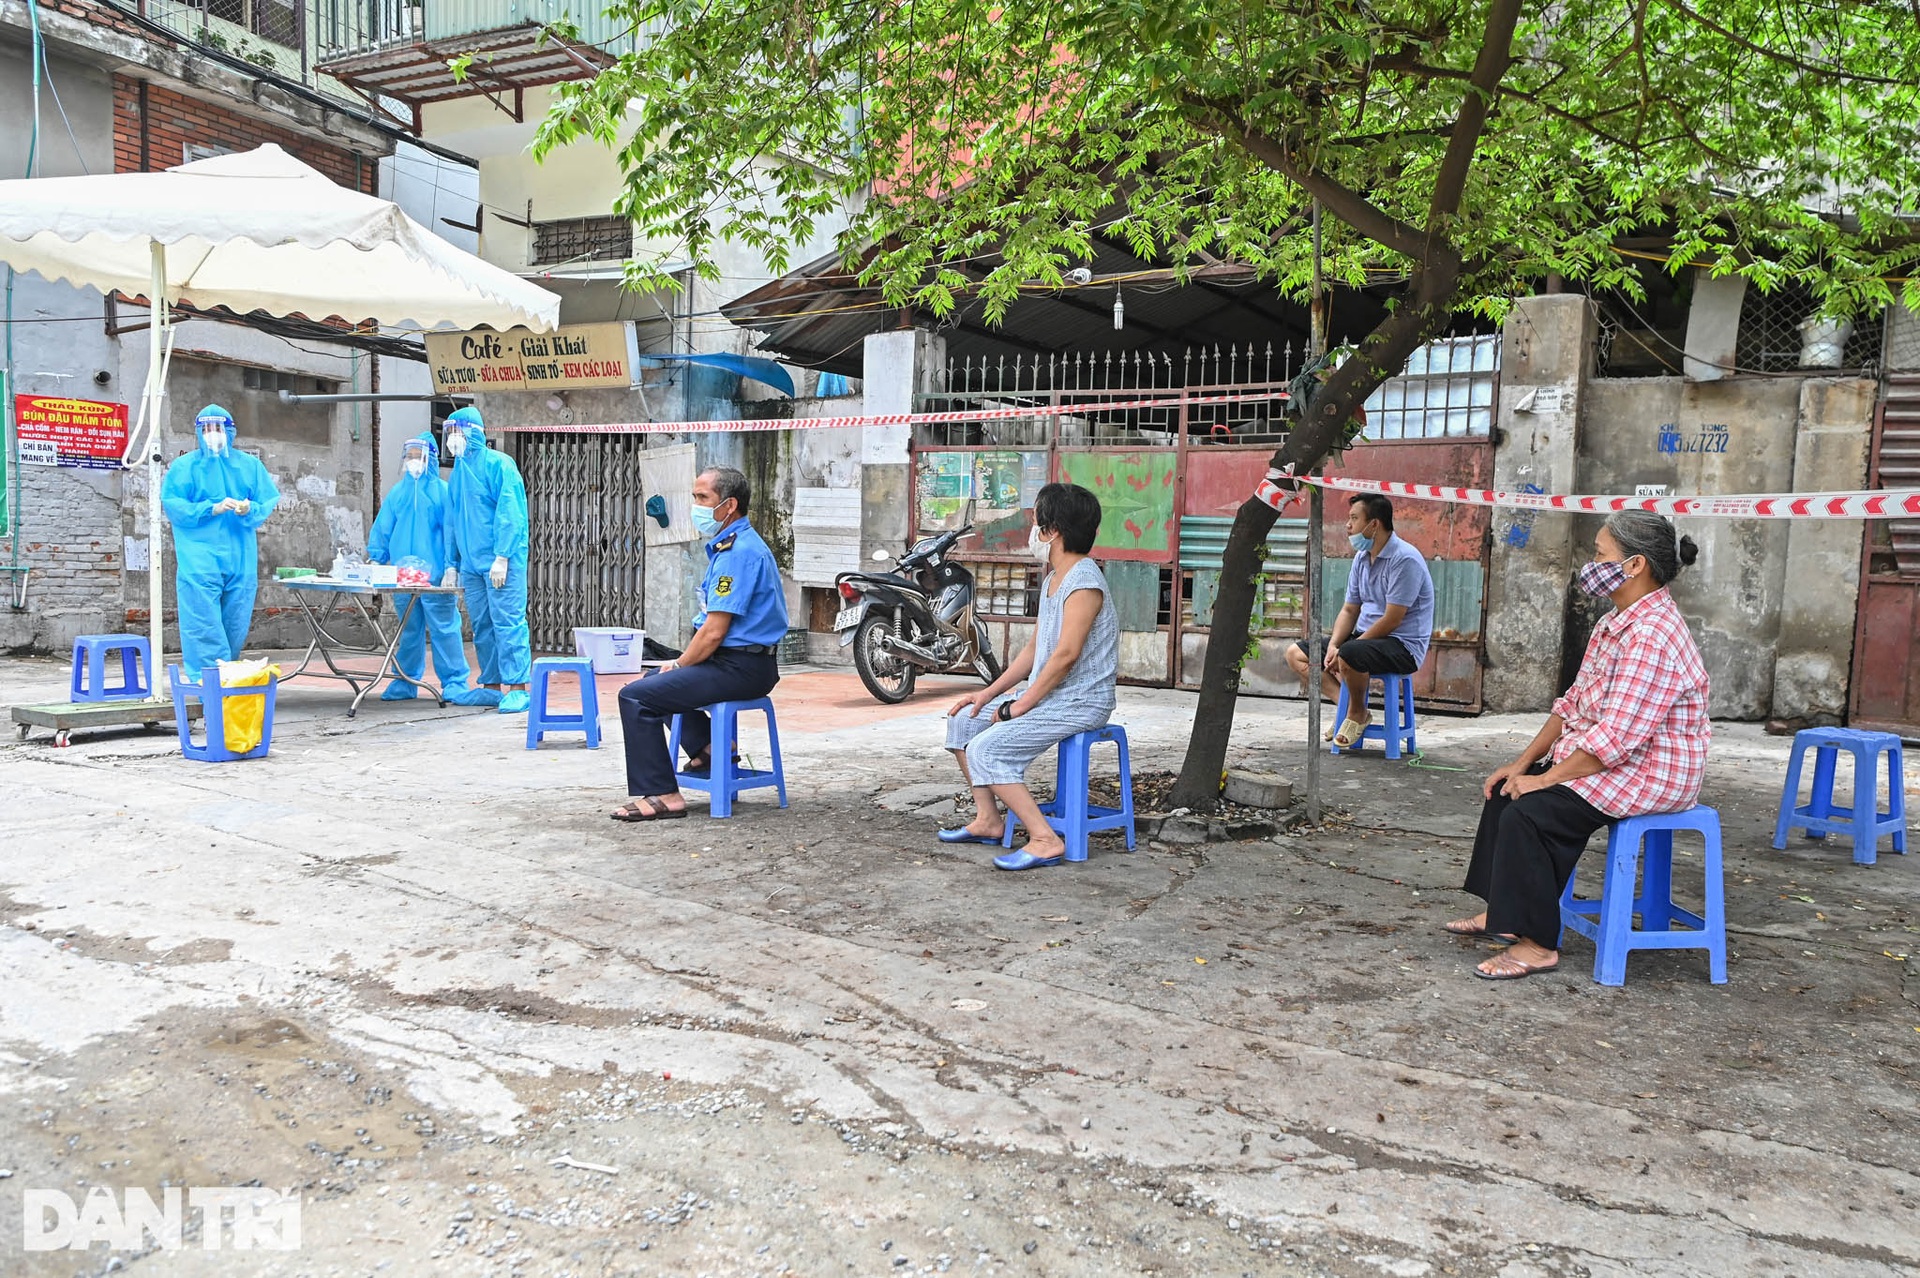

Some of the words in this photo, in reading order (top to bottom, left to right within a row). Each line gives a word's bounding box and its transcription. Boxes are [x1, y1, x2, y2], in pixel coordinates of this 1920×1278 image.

[461, 334, 504, 360] Café
[521, 337, 549, 357] Giải
[552, 336, 588, 355] Khát
[437, 366, 456, 384] SỮA
[455, 367, 476, 383] TƯƠI
[481, 364, 498, 382] SỮA
[498, 366, 522, 382] CHUA
[527, 364, 547, 380] SINH
[548, 359, 559, 379] TỐ
[563, 362, 582, 378] KEM
[582, 359, 601, 377] CÁC
[601, 361, 622, 379] LOẠI
[23, 410, 45, 421] BÚN
[21, 454, 44, 463] MANG
